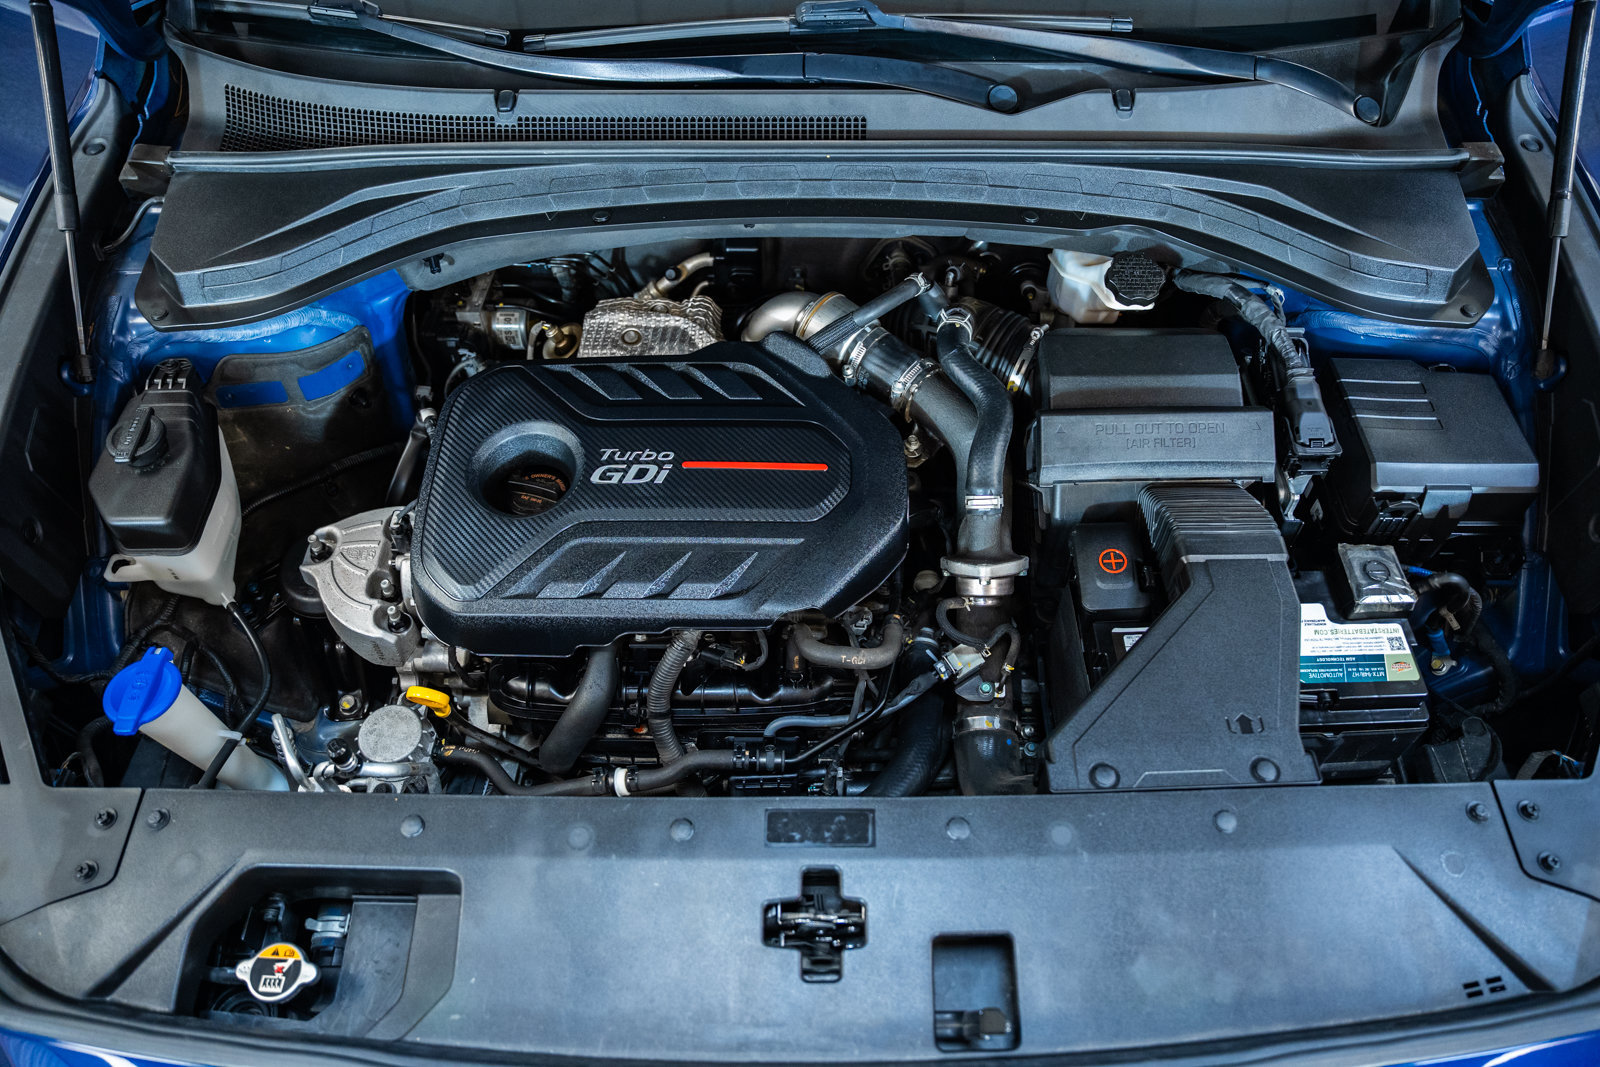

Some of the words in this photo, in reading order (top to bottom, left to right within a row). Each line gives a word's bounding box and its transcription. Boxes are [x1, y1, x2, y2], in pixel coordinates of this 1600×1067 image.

[1095, 423, 1131, 435] PULL
[1134, 422, 1163, 435] OUT
[1166, 422, 1184, 434] TO
[1188, 422, 1225, 434] OPEN
[600, 448, 675, 461] Turbo
[590, 464, 673, 484] GDi
[1313, 627, 1400, 636] INTERSTATEBATTERIES.COM
